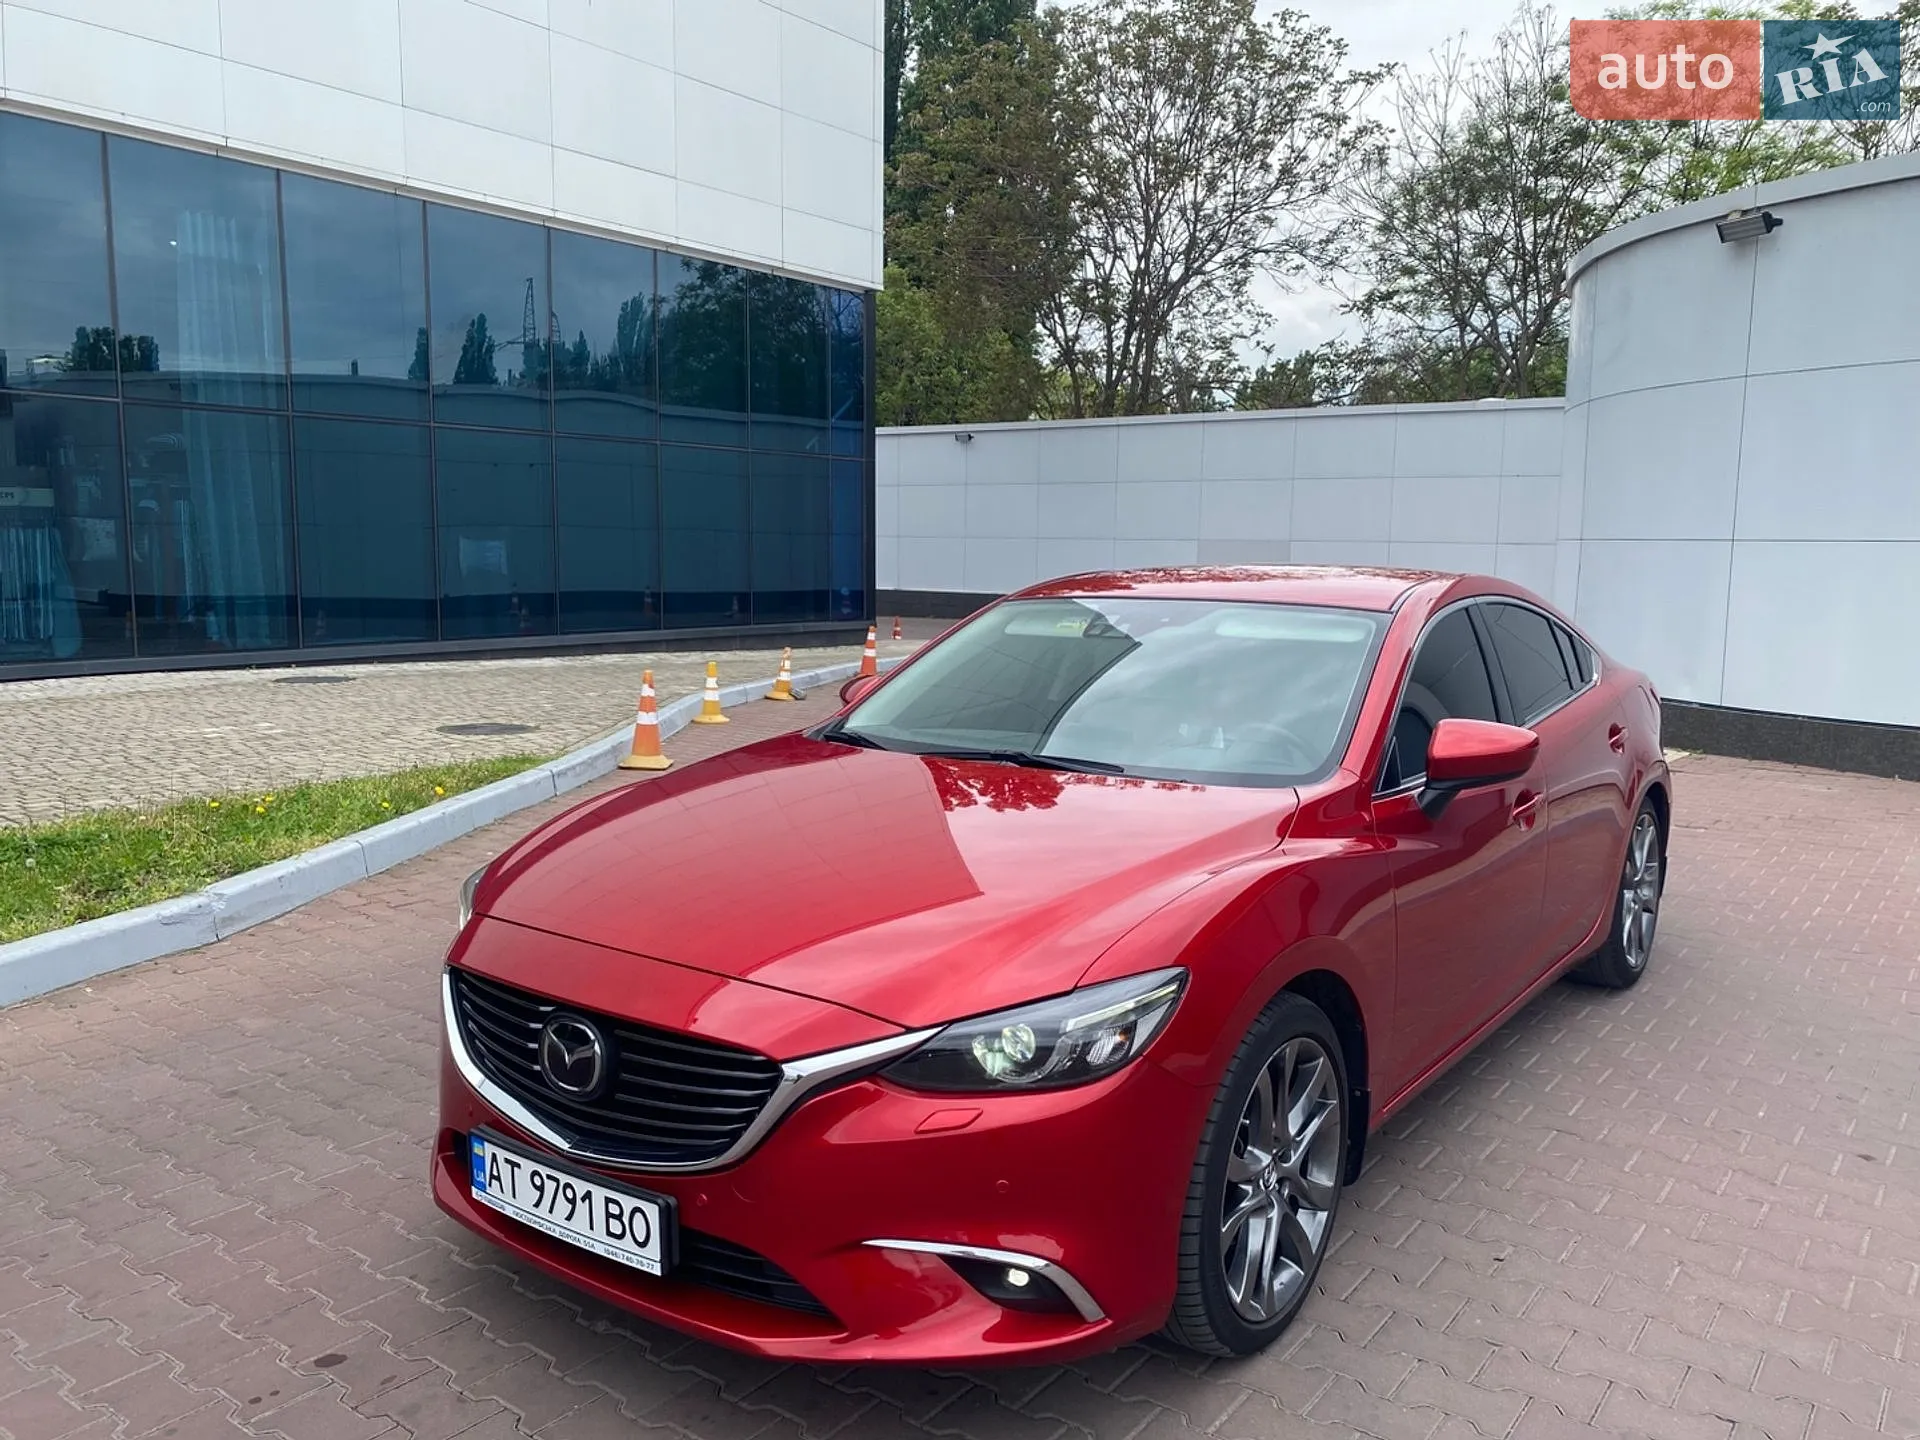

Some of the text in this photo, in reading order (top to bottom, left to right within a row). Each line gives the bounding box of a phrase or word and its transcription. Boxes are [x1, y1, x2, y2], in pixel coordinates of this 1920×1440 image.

[488, 1151, 651, 1249] AT 9791 BO
